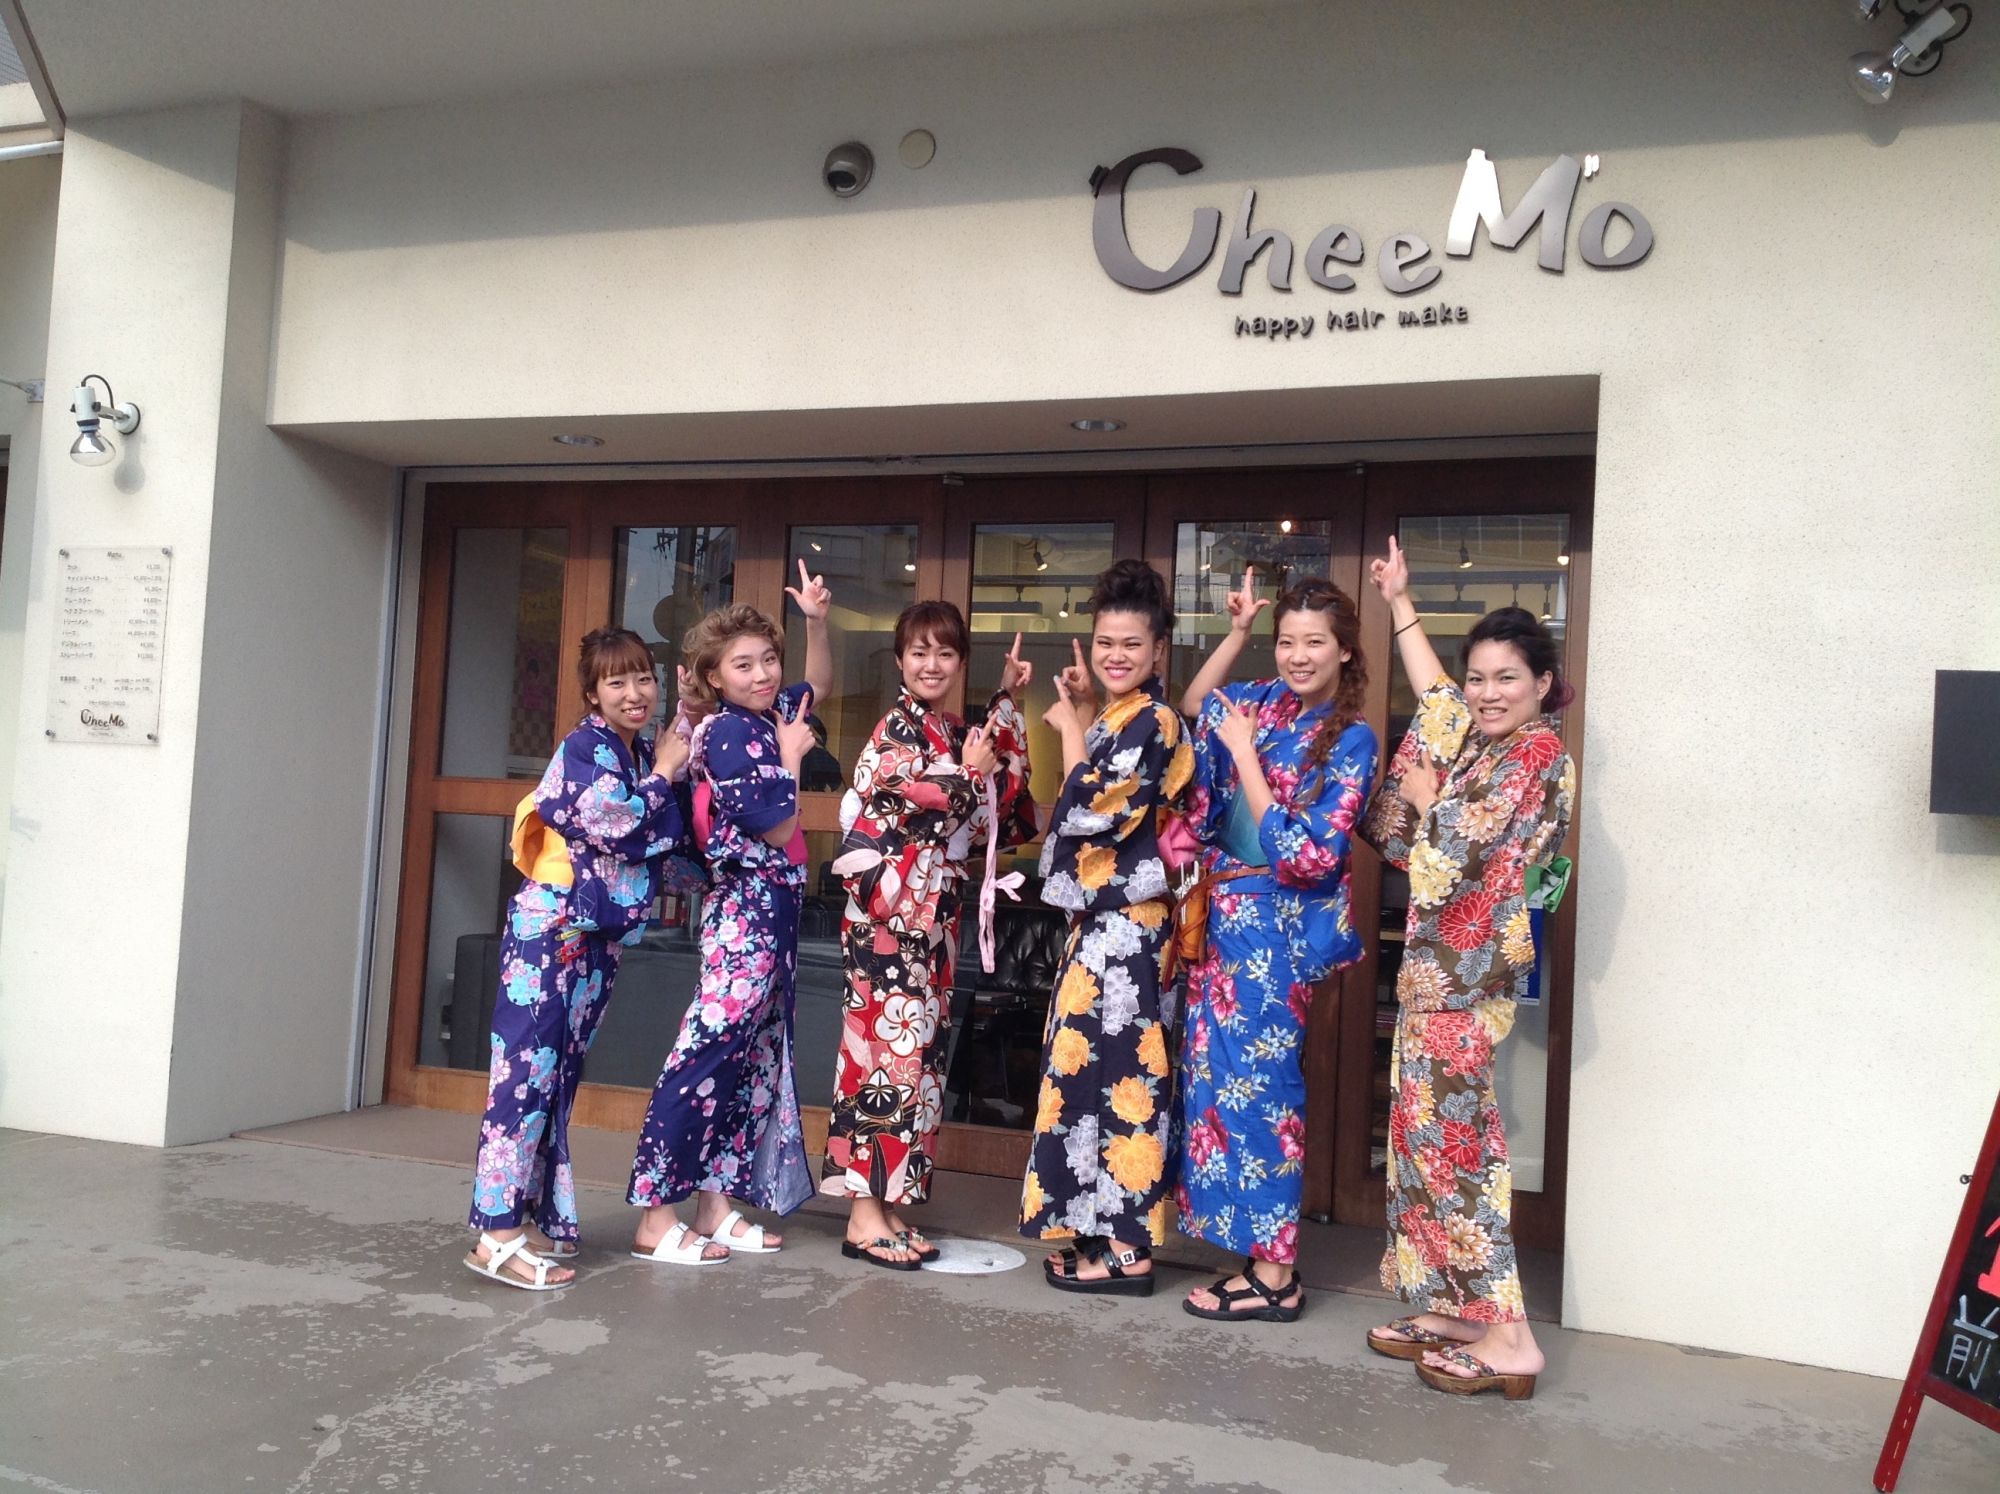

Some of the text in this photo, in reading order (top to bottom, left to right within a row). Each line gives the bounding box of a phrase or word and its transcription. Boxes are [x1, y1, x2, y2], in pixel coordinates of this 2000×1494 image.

[1089, 148, 1654, 296] CheeMo
[1234, 303, 1469, 340] happy hair make
[80, 708, 125, 728] CheeMo
